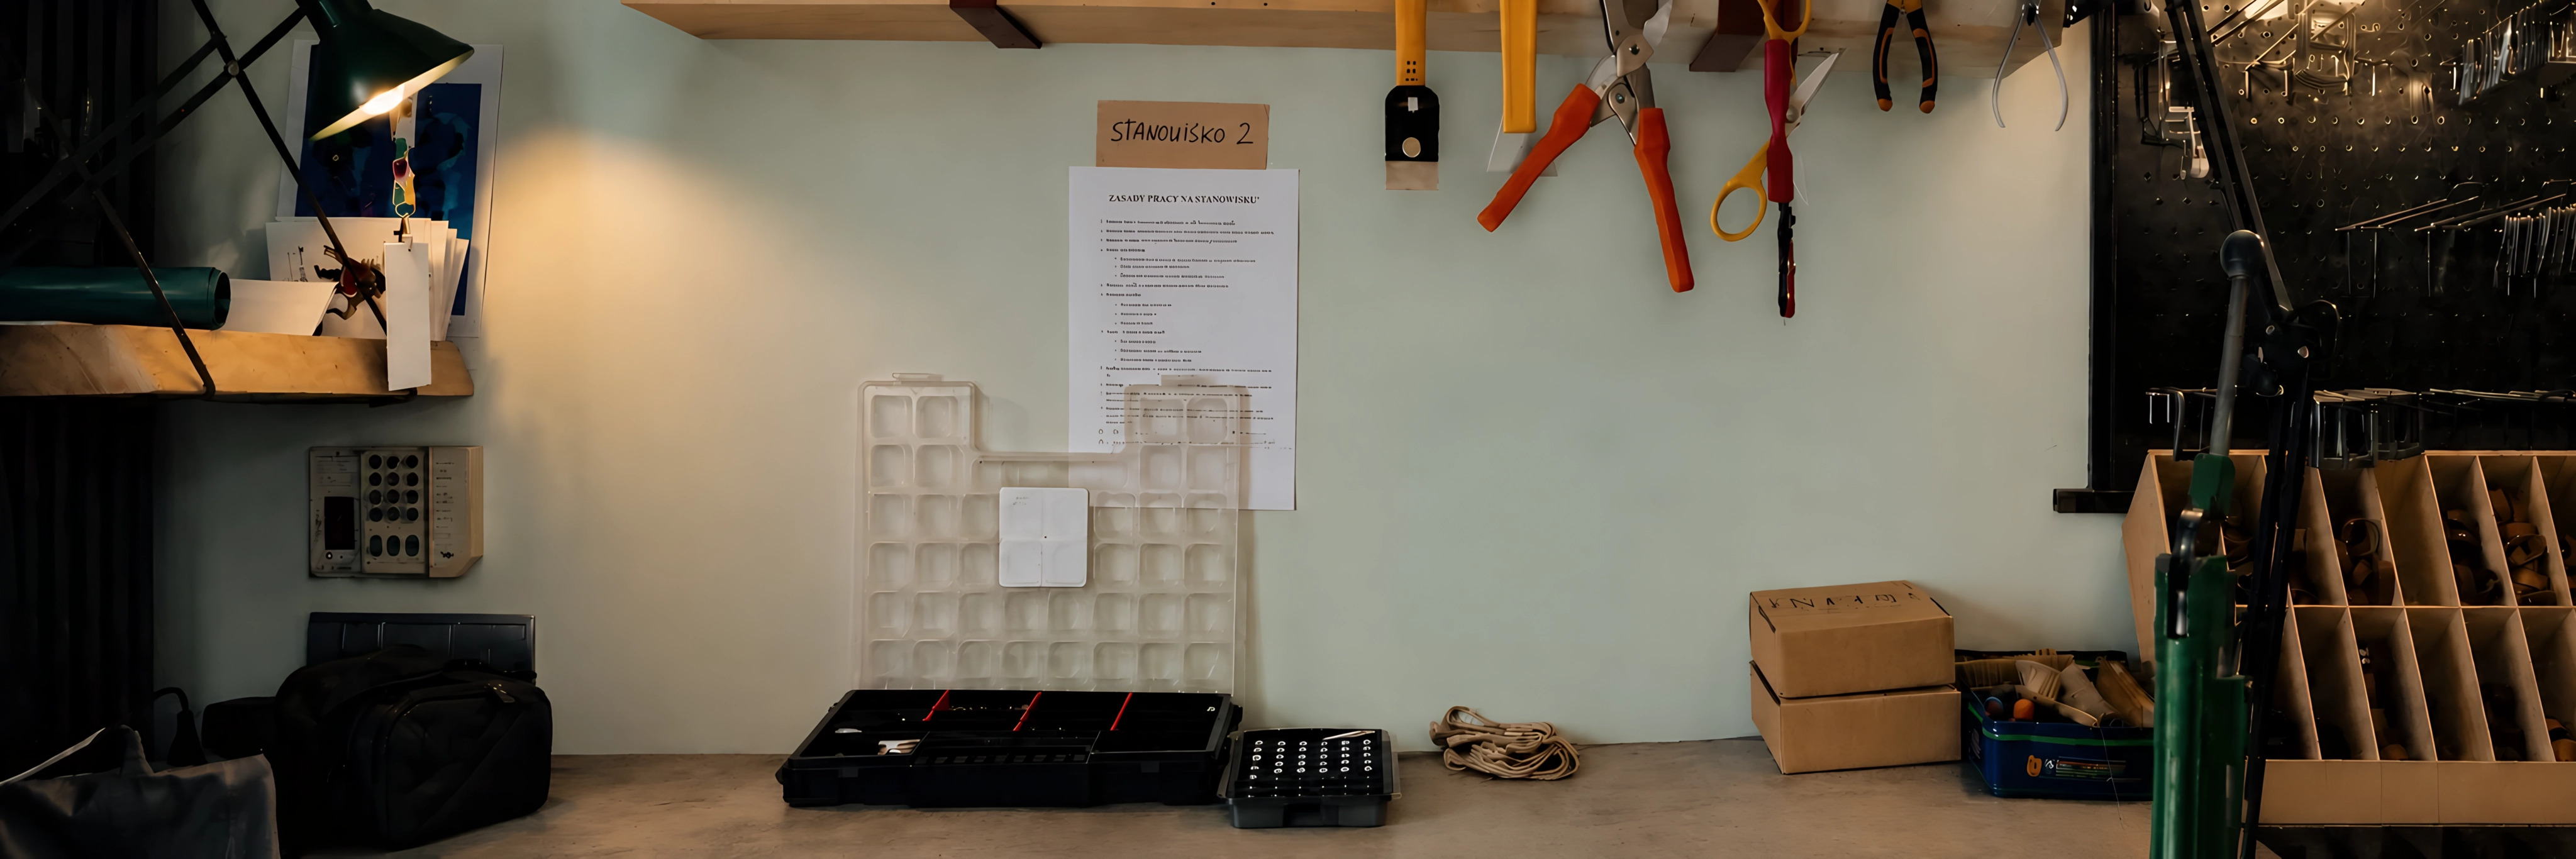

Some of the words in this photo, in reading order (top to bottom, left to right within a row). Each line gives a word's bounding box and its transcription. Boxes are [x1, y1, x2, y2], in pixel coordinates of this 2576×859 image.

[1236, 122, 1253, 145] 2
[1109, 194, 1145, 202] ZASADY
[1148, 195, 1179, 203] PRACY
